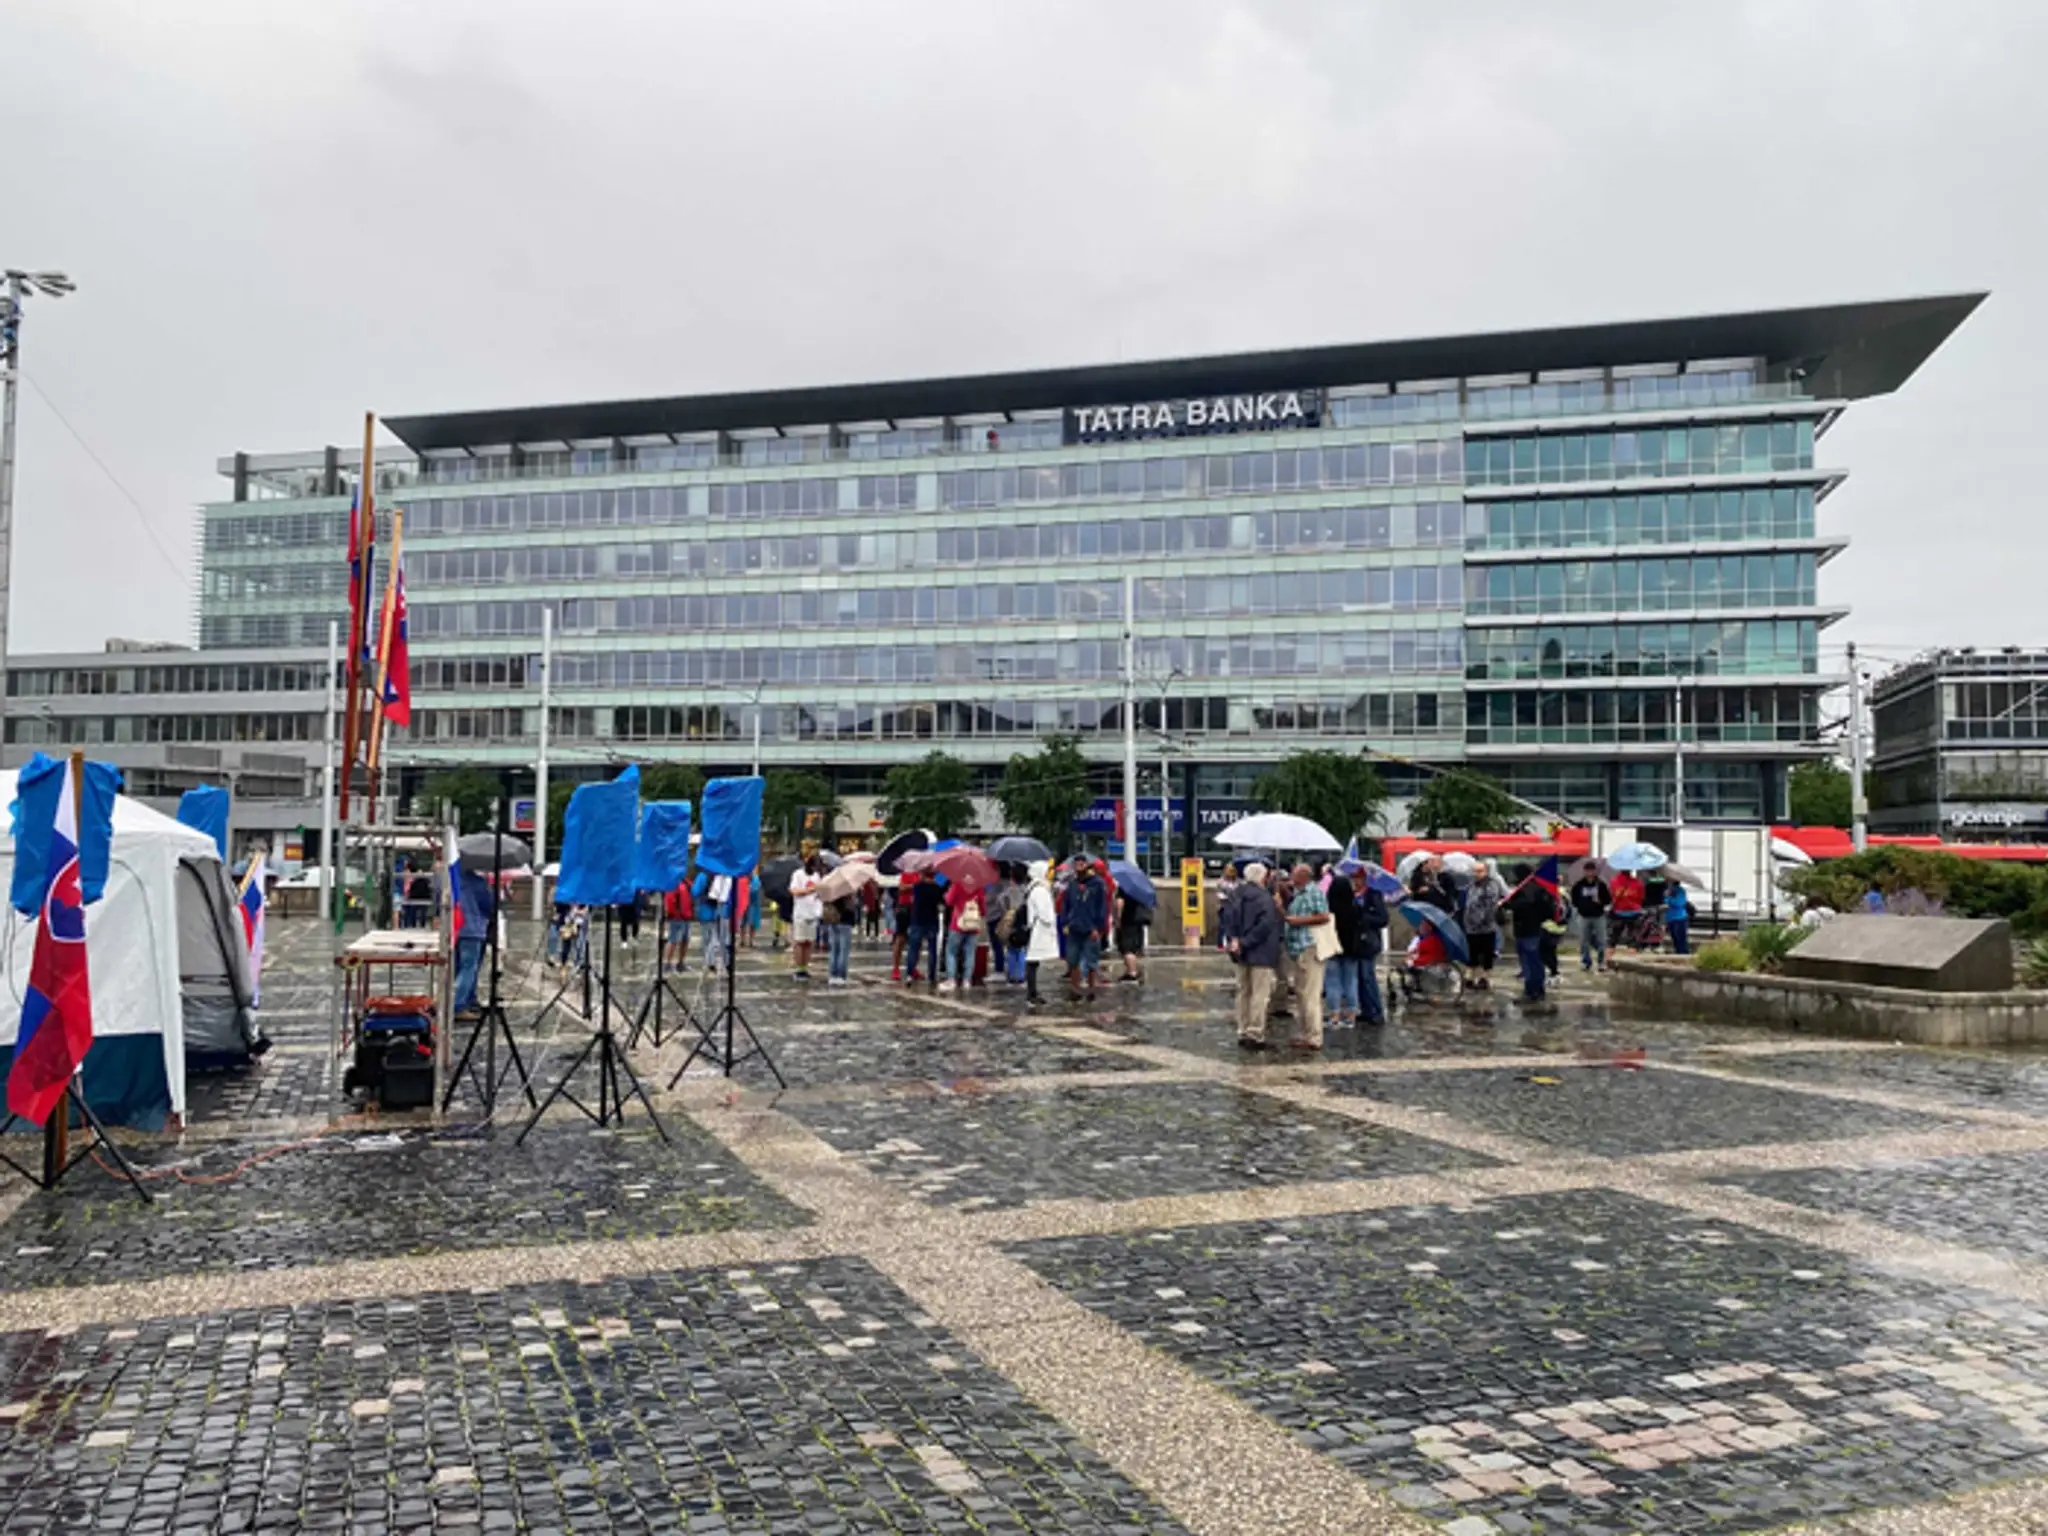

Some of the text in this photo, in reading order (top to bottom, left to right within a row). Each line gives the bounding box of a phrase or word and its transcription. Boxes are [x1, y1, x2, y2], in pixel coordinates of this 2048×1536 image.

[1073, 392, 1304, 433] TATRA BANKA
[1951, 808, 2026, 828] gorenje
